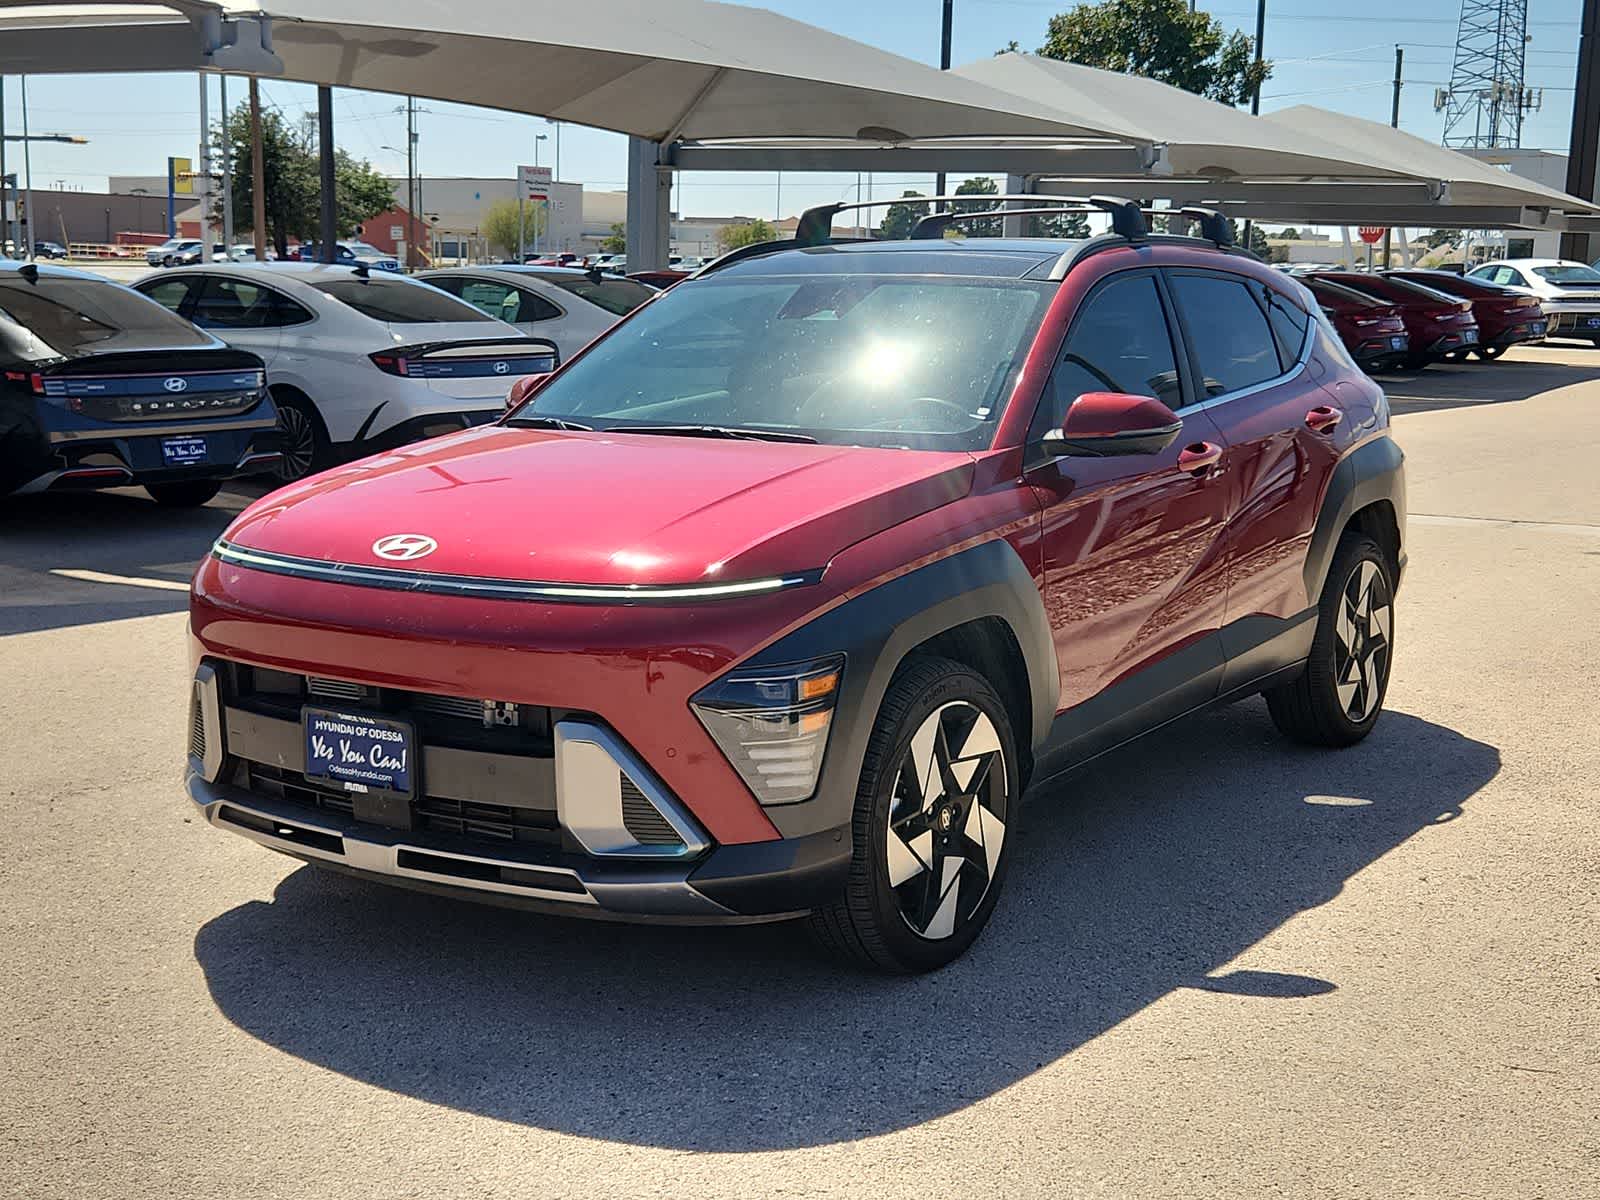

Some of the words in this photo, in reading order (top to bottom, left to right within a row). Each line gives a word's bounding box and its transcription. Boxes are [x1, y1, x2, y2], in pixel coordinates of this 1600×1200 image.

[132, 400, 225, 411] SONATA
[315, 720, 355, 735] HYUNDAI
[356, 726, 368, 737] OF
[369, 728, 403, 743] ODESSA
[312, 735, 334, 760] Yes
[340, 739, 366, 763] You
[370, 744, 407, 773] Can!
[328, 764, 393, 782] OdessaHyundai.com
